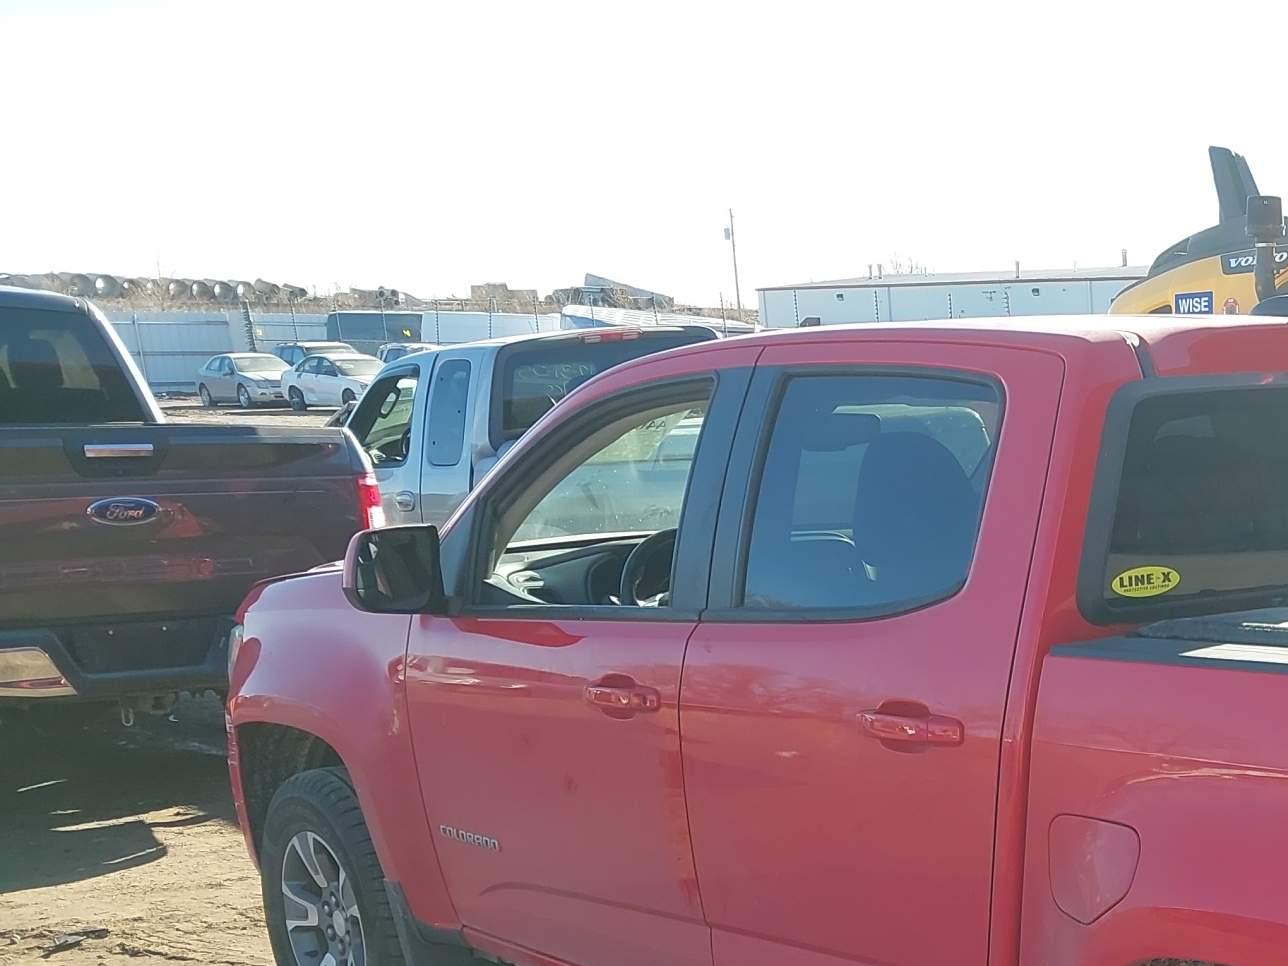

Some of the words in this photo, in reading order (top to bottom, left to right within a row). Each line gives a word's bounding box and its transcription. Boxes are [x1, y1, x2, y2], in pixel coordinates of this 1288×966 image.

[1228, 251, 1288, 269] VOO
[1179, 296, 1209, 313] WISE
[106, 502, 144, 520] Ford
[1119, 571, 1173, 588] LINE-X
[439, 823, 499, 849] COLORADO
